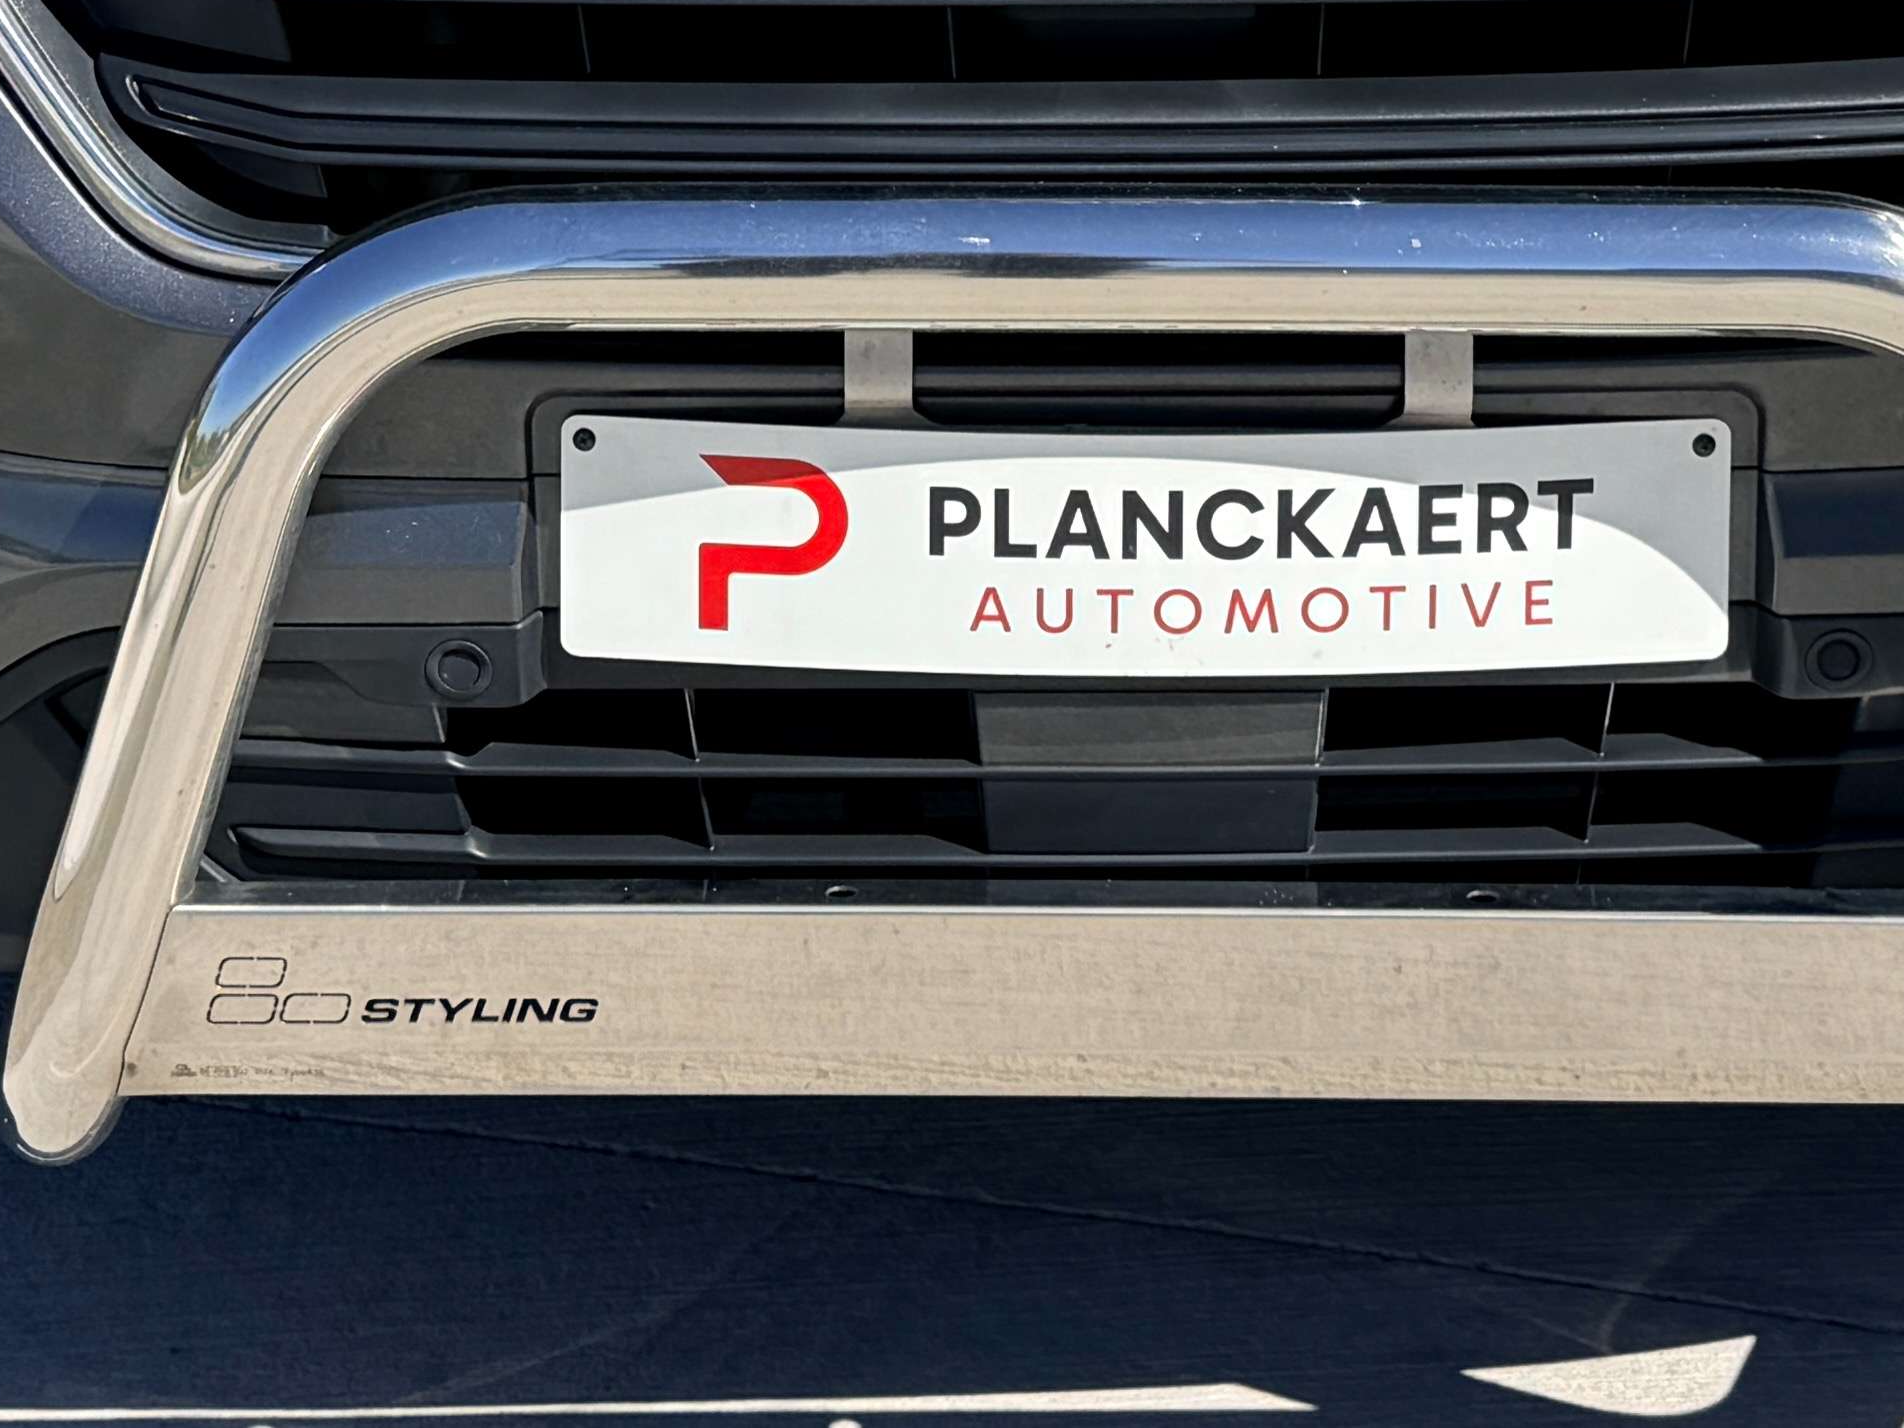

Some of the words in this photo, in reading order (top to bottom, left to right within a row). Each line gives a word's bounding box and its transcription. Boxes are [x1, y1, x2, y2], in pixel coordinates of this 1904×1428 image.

[928, 477, 1595, 560] PLANCKAERT
[970, 580, 1555, 635] AUTOMOTIVE
[361, 998, 599, 1023] STYLING
